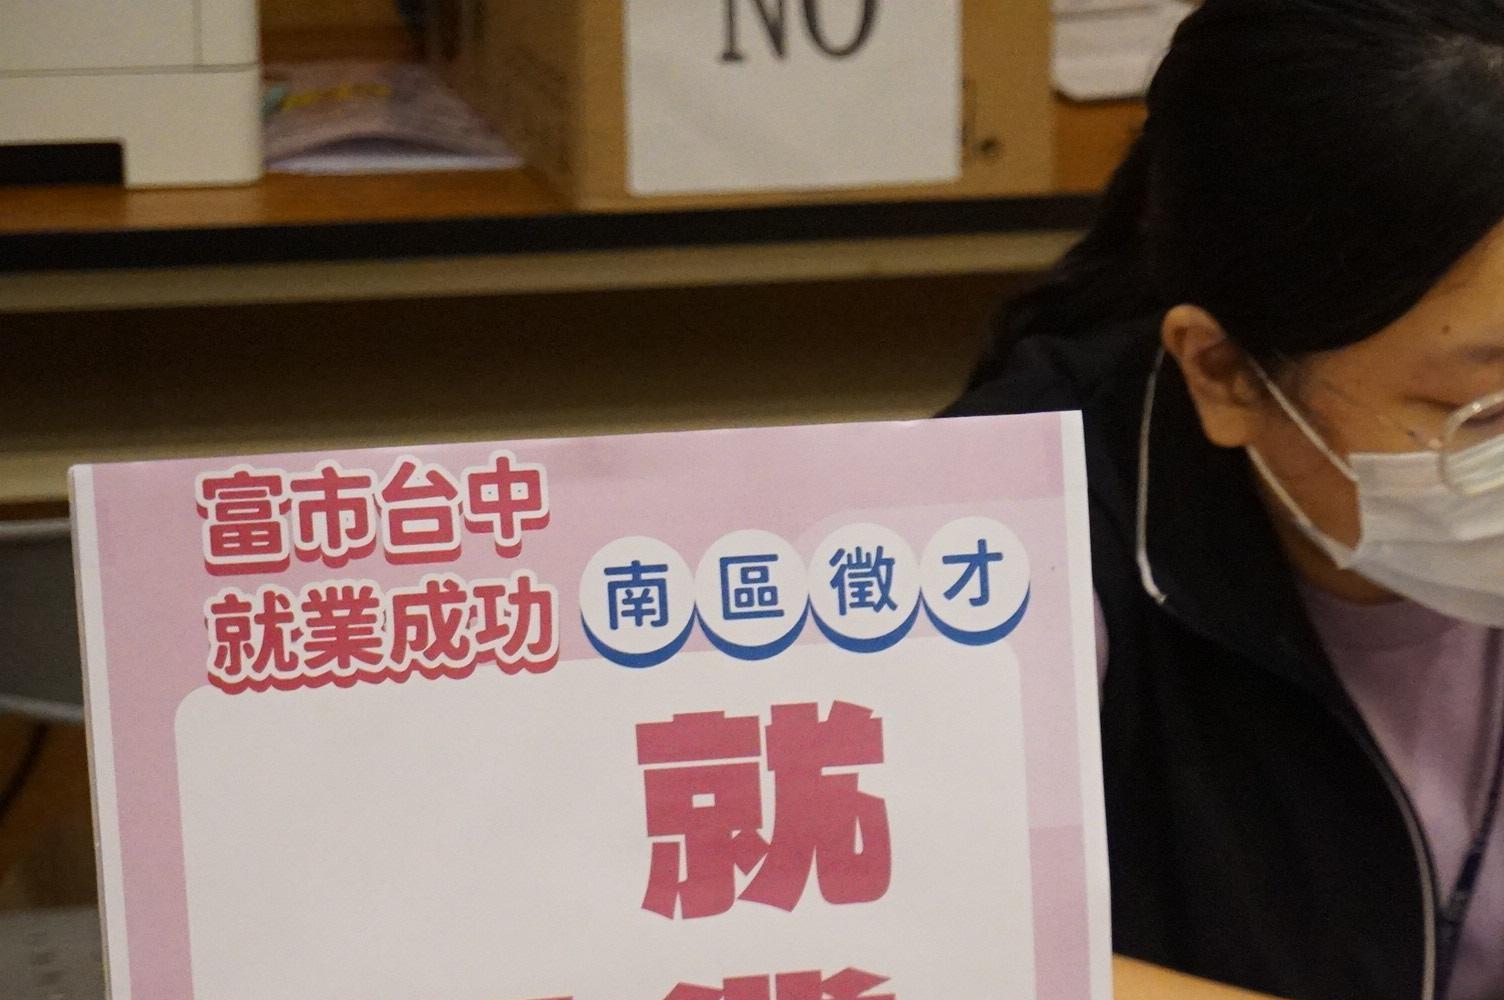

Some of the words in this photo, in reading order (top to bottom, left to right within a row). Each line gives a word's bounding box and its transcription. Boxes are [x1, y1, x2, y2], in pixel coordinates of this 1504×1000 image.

[717, 0, 880, 63] NO
[198, 452, 549, 574] 富市台中
[206, 570, 560, 692] 就業成功
[603, 537, 1005, 632] 南區徵才
